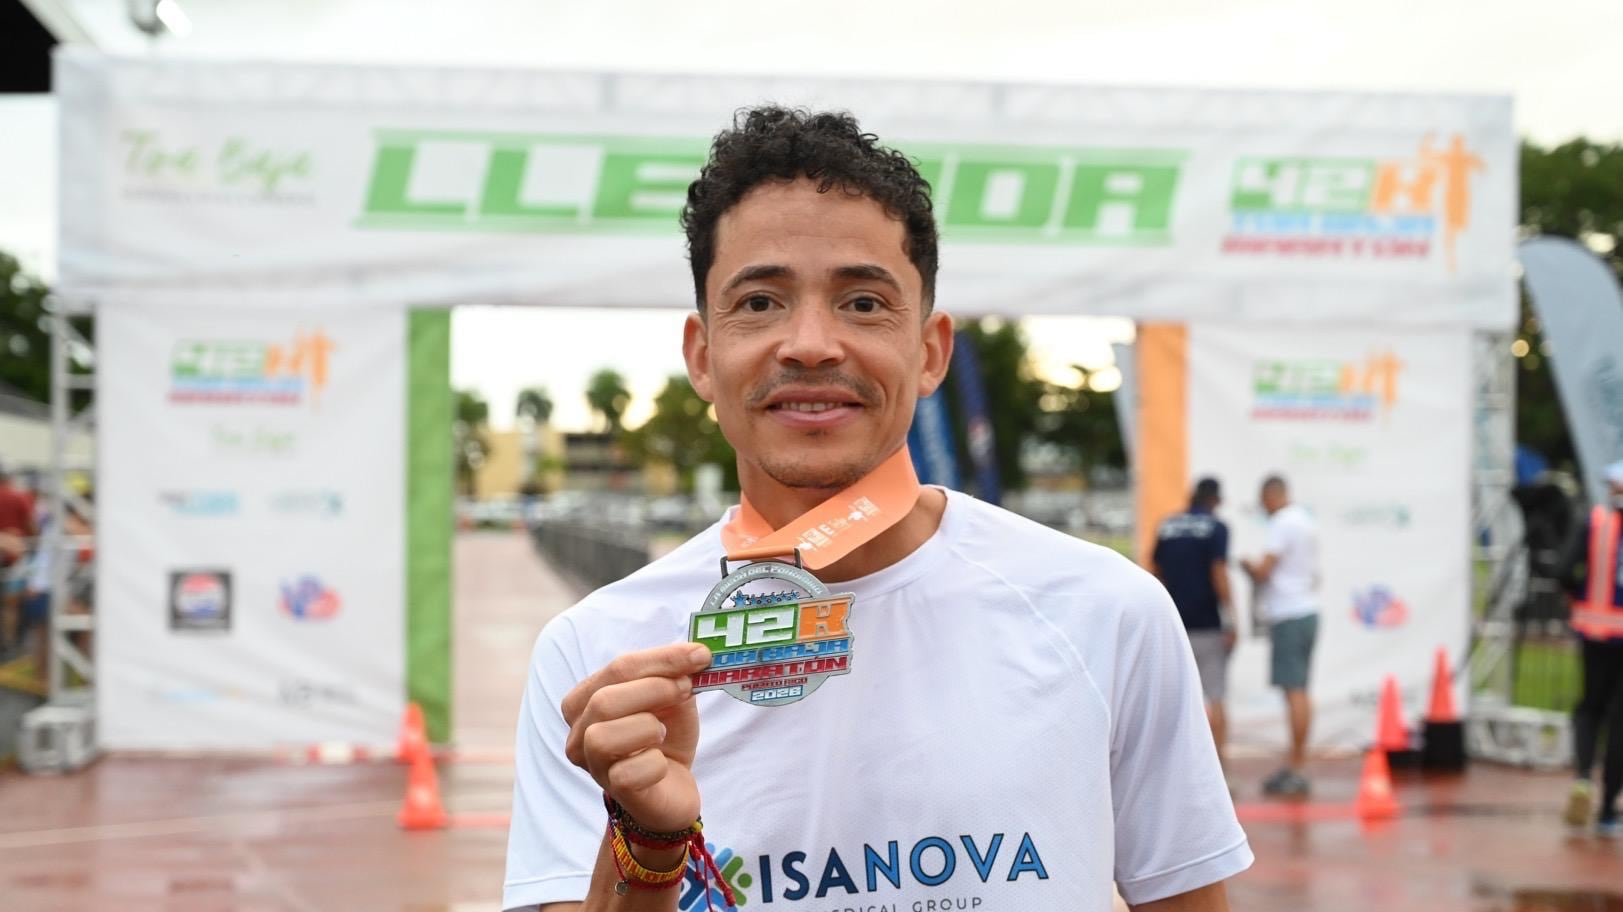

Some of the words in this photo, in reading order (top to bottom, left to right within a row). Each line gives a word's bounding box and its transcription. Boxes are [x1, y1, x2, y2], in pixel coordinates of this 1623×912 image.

[360, 136, 1185, 234] LLEDA
[696, 602, 850, 648] 42K
[711, 651, 758, 668] OA
[761, 639, 849, 661] BAJA
[759, 832, 1049, 904] ISANOVA
[912, 897, 982, 912] GROUP
